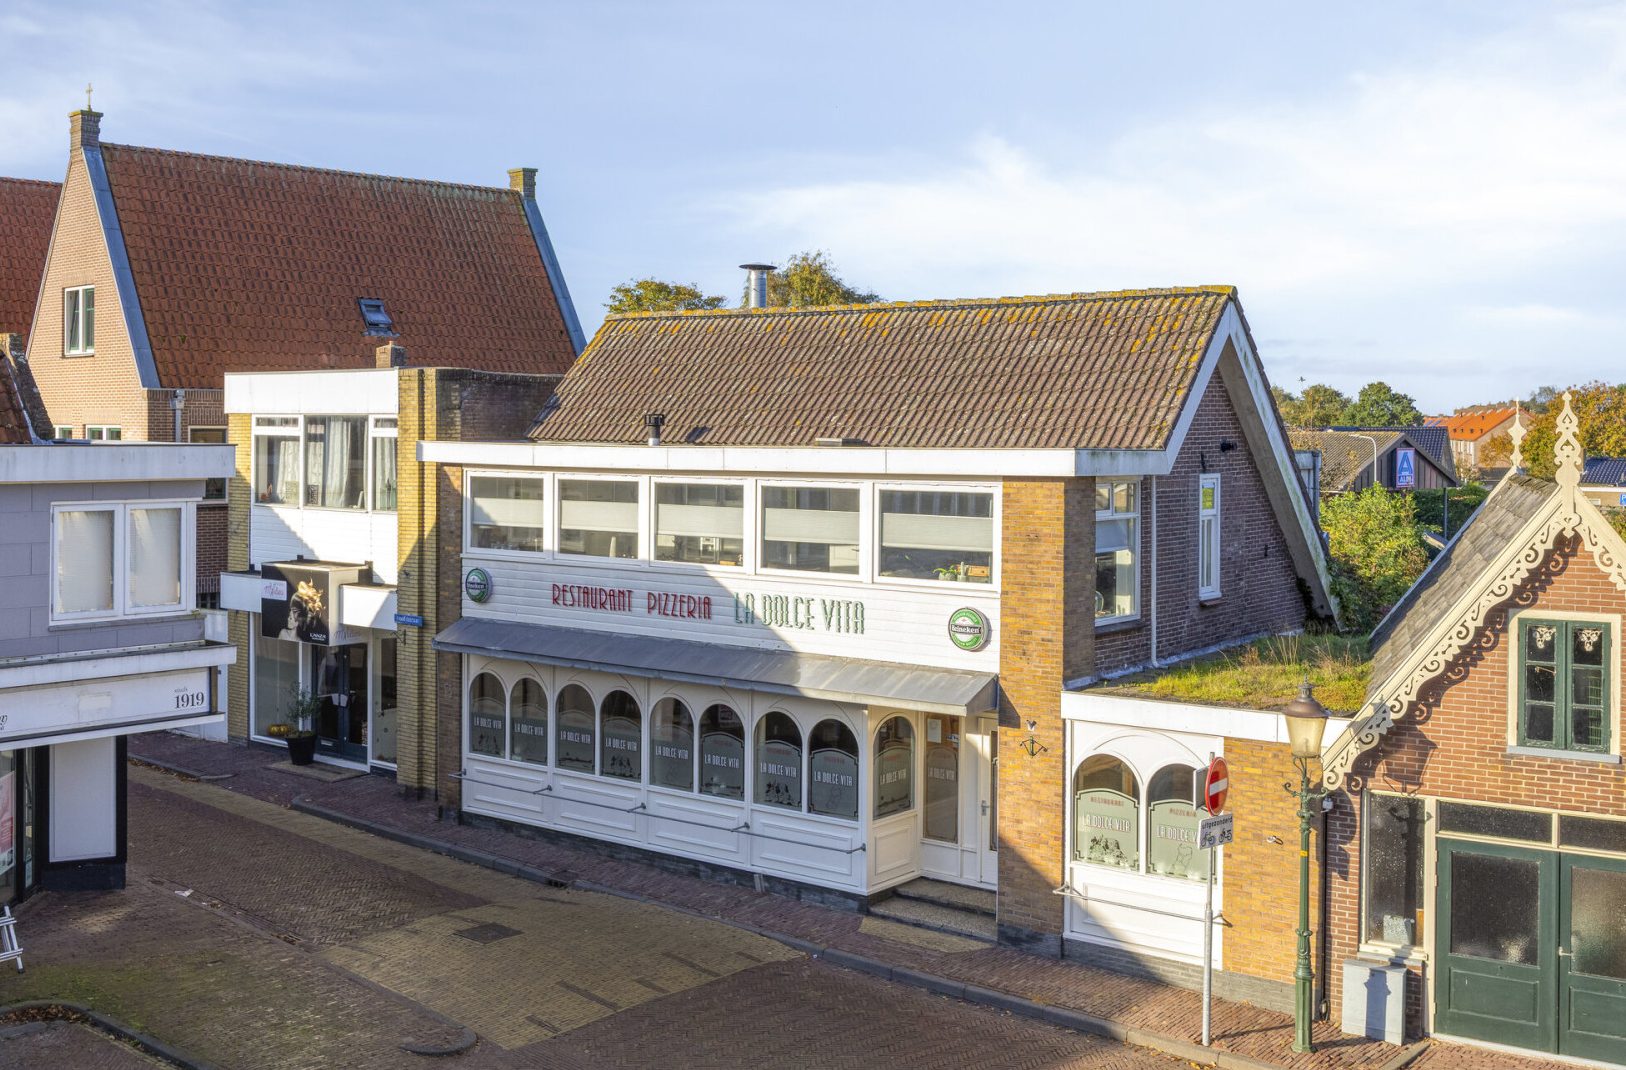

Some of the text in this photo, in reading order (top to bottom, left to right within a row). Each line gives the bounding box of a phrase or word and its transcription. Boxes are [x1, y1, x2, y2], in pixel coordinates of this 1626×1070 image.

[552, 583, 865, 634] RESTAURANT PIZZERIA LA DOLCE VITA
[174, 692, 204, 709] 1919
[655, 745, 689, 760] LA DOLCE VITA
[704, 754, 740, 769] LA DOLCE VITA
[760, 762, 797, 778] LA DOLCE VITA
[814, 771, 853, 786] LA DOLCE VITA
[1082, 812, 1132, 832] LA DOLCE VITA
[1202, 815, 1233, 830] uitgezonderd
[1156, 824, 1167, 838] LA
[1168, 827, 1189, 842] DOLCE
